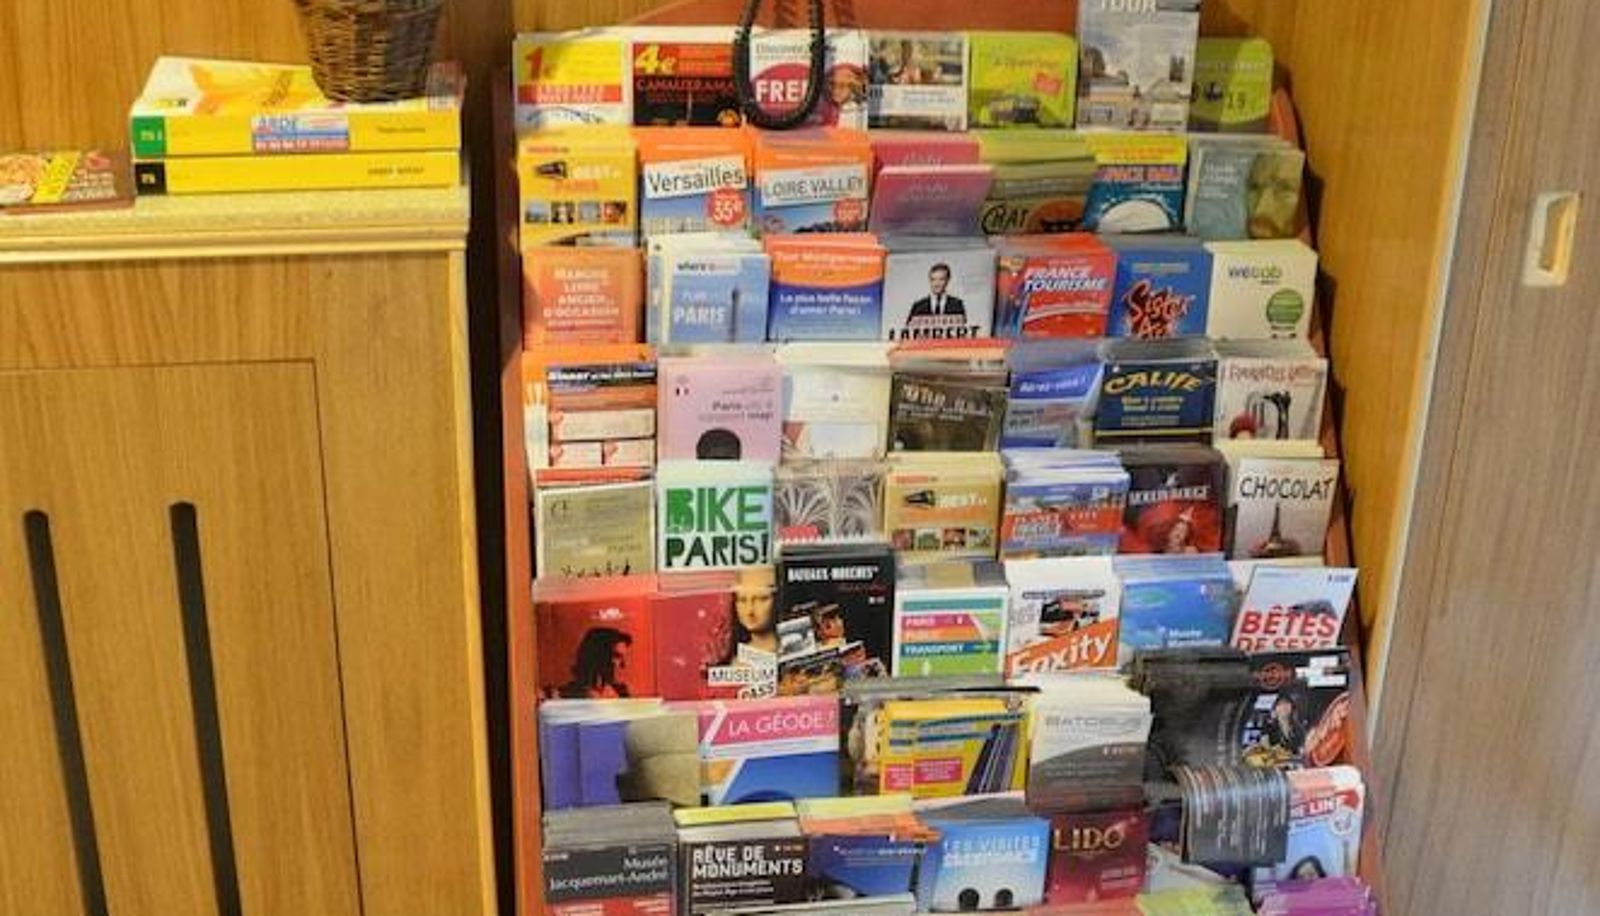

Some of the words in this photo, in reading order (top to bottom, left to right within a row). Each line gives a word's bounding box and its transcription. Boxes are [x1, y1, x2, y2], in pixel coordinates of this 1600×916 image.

[647, 166, 744, 193] Versailles
[1239, 477, 1335, 501] CHOCOLAT
[665, 486, 770, 534] BIKE
[664, 531, 770, 567] PARIS!
[1239, 604, 1339, 638] BÊTES
[710, 667, 775, 682] MUSEUM
[729, 720, 753, 736] LA
[1053, 826, 1126, 850] LIDO
[623, 855, 669, 871] Musée
[692, 858, 804, 879] MONUMENTS
